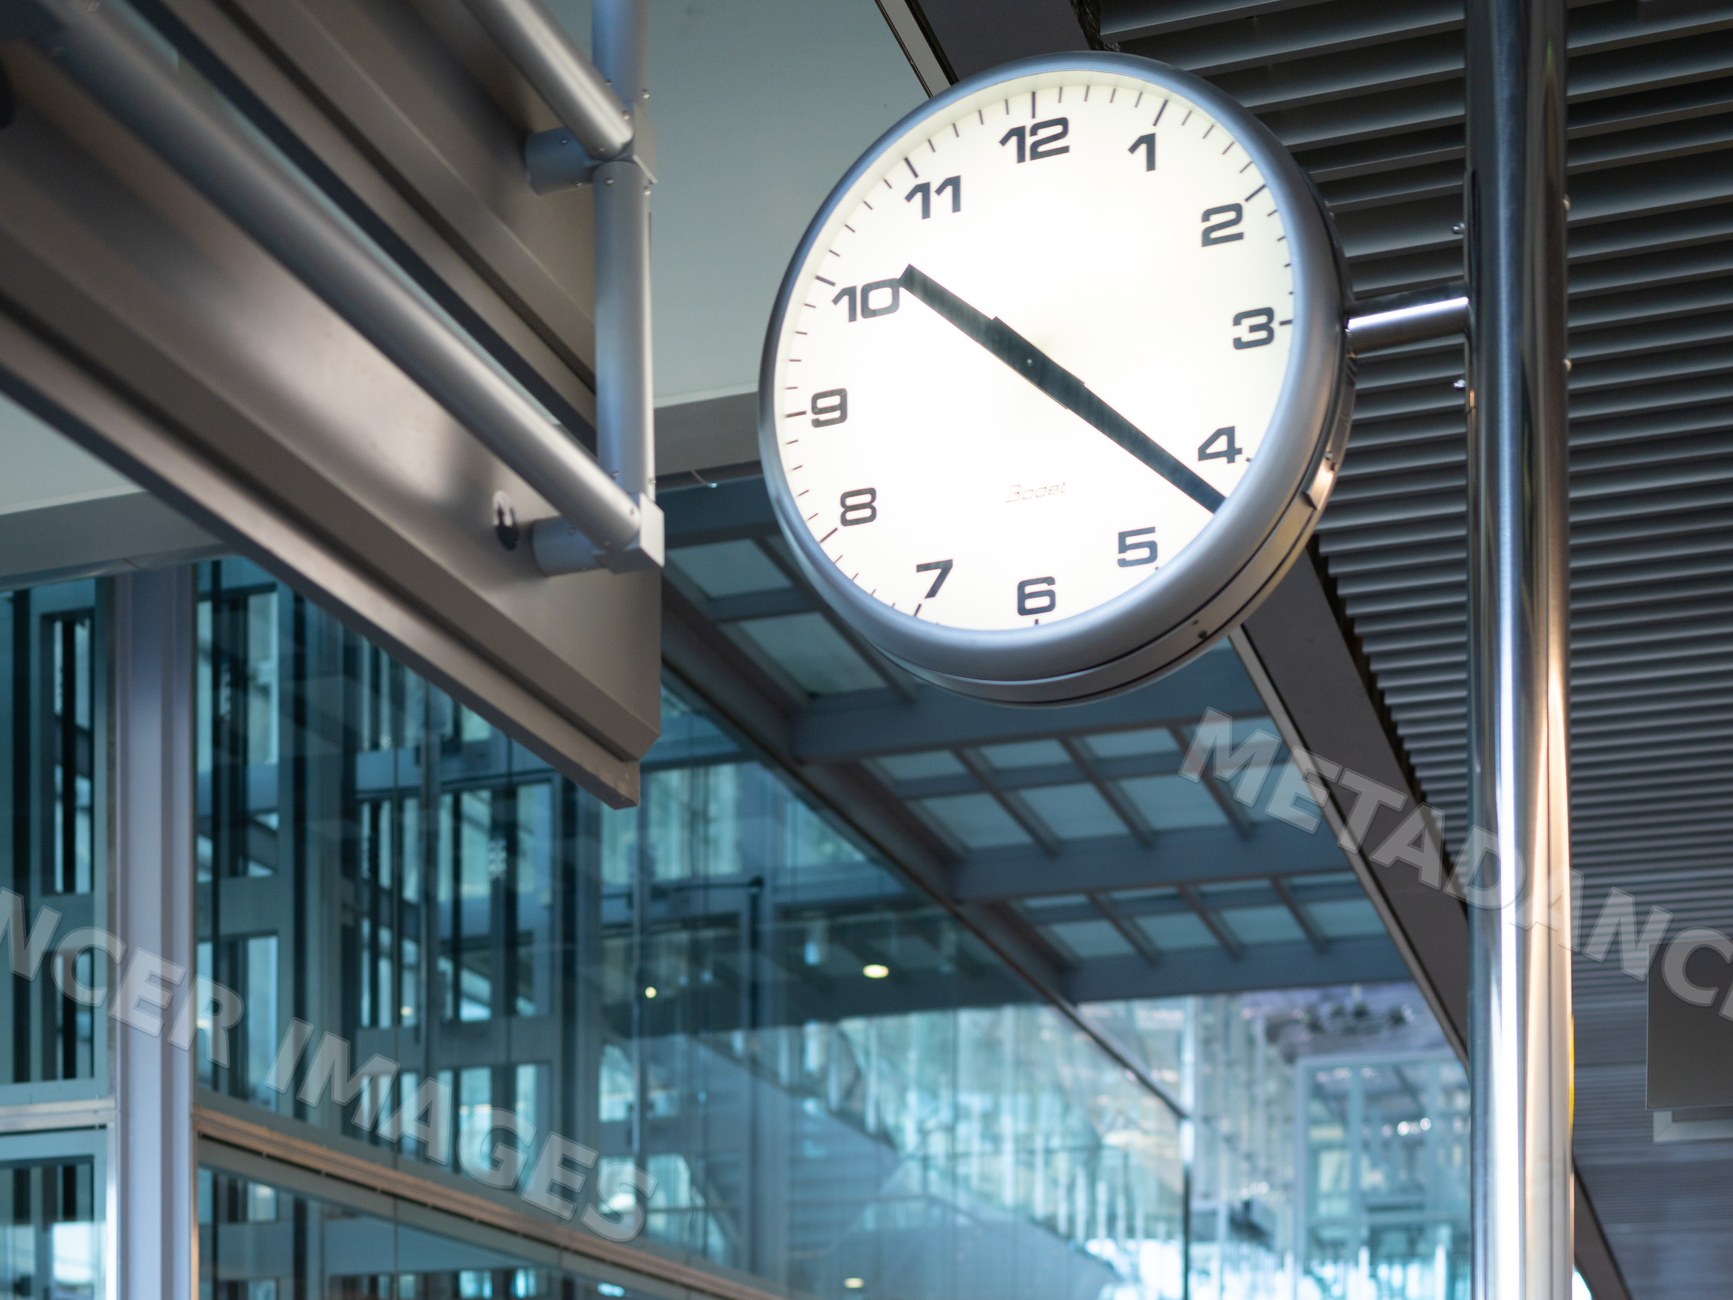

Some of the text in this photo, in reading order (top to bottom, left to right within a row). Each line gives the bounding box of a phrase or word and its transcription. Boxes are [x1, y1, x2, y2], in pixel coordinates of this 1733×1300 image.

[999, 116, 1070, 164] 12
[1128, 132, 1157, 173] 1
[904, 174, 963, 221] 11
[1200, 202, 1245, 248] 2
[831, 277, 901, 323] 10
[1232, 306, 1275, 351] 3
[810, 387, 849, 429] 9
[1197, 426, 1243, 465] 4
[839, 487, 878, 528] 8
[1116, 526, 1160, 569] 5
[915, 558, 955, 600] 7
[1016, 576, 1057, 617] 6
